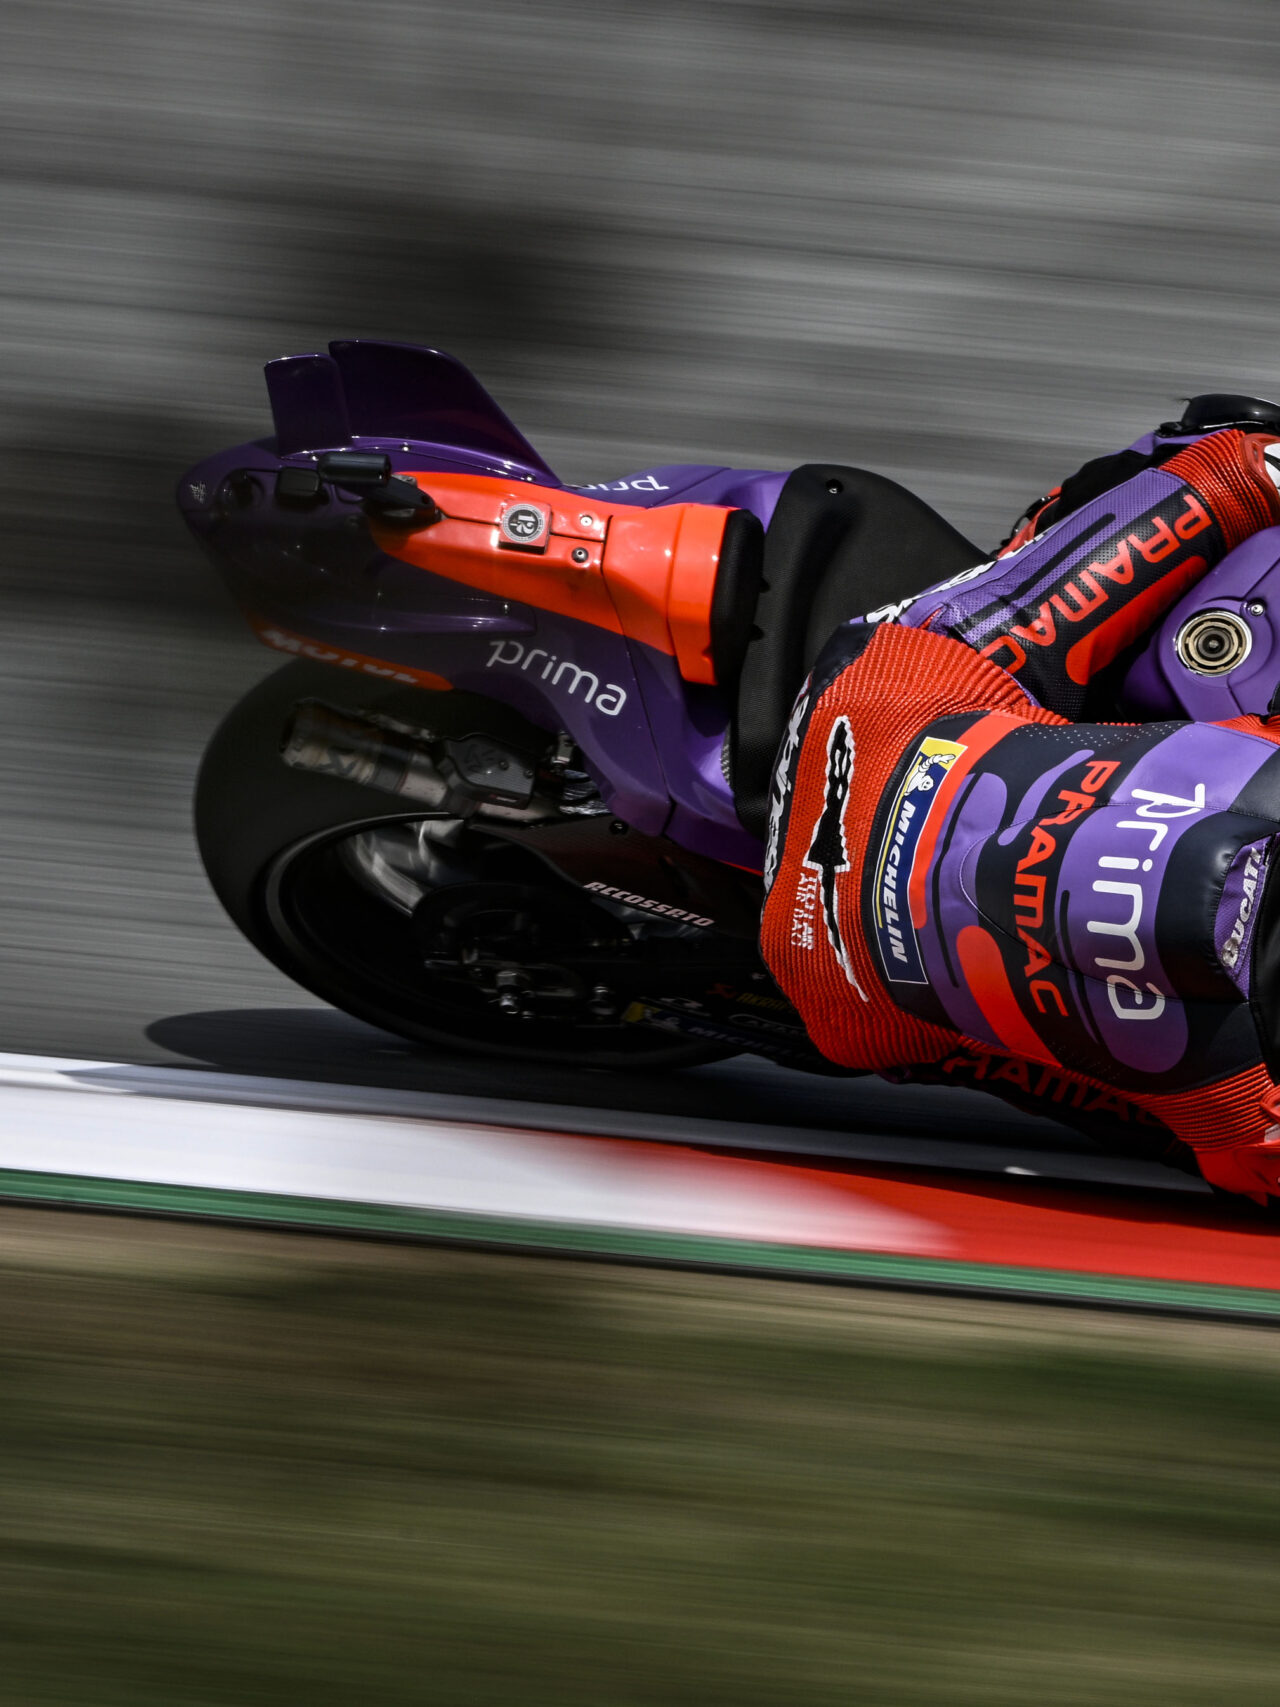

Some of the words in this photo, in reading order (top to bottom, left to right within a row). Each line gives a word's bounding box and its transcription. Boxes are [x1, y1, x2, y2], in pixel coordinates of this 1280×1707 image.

[980, 493, 1215, 674] PRAMAC
[486, 639, 628, 716] prima
[583, 880, 716, 928] ACCOSSATO
[887, 799, 917, 964] MICHELIN
[1014, 760, 1121, 1018] PRAMAC
[1087, 783, 1206, 1020] prima
